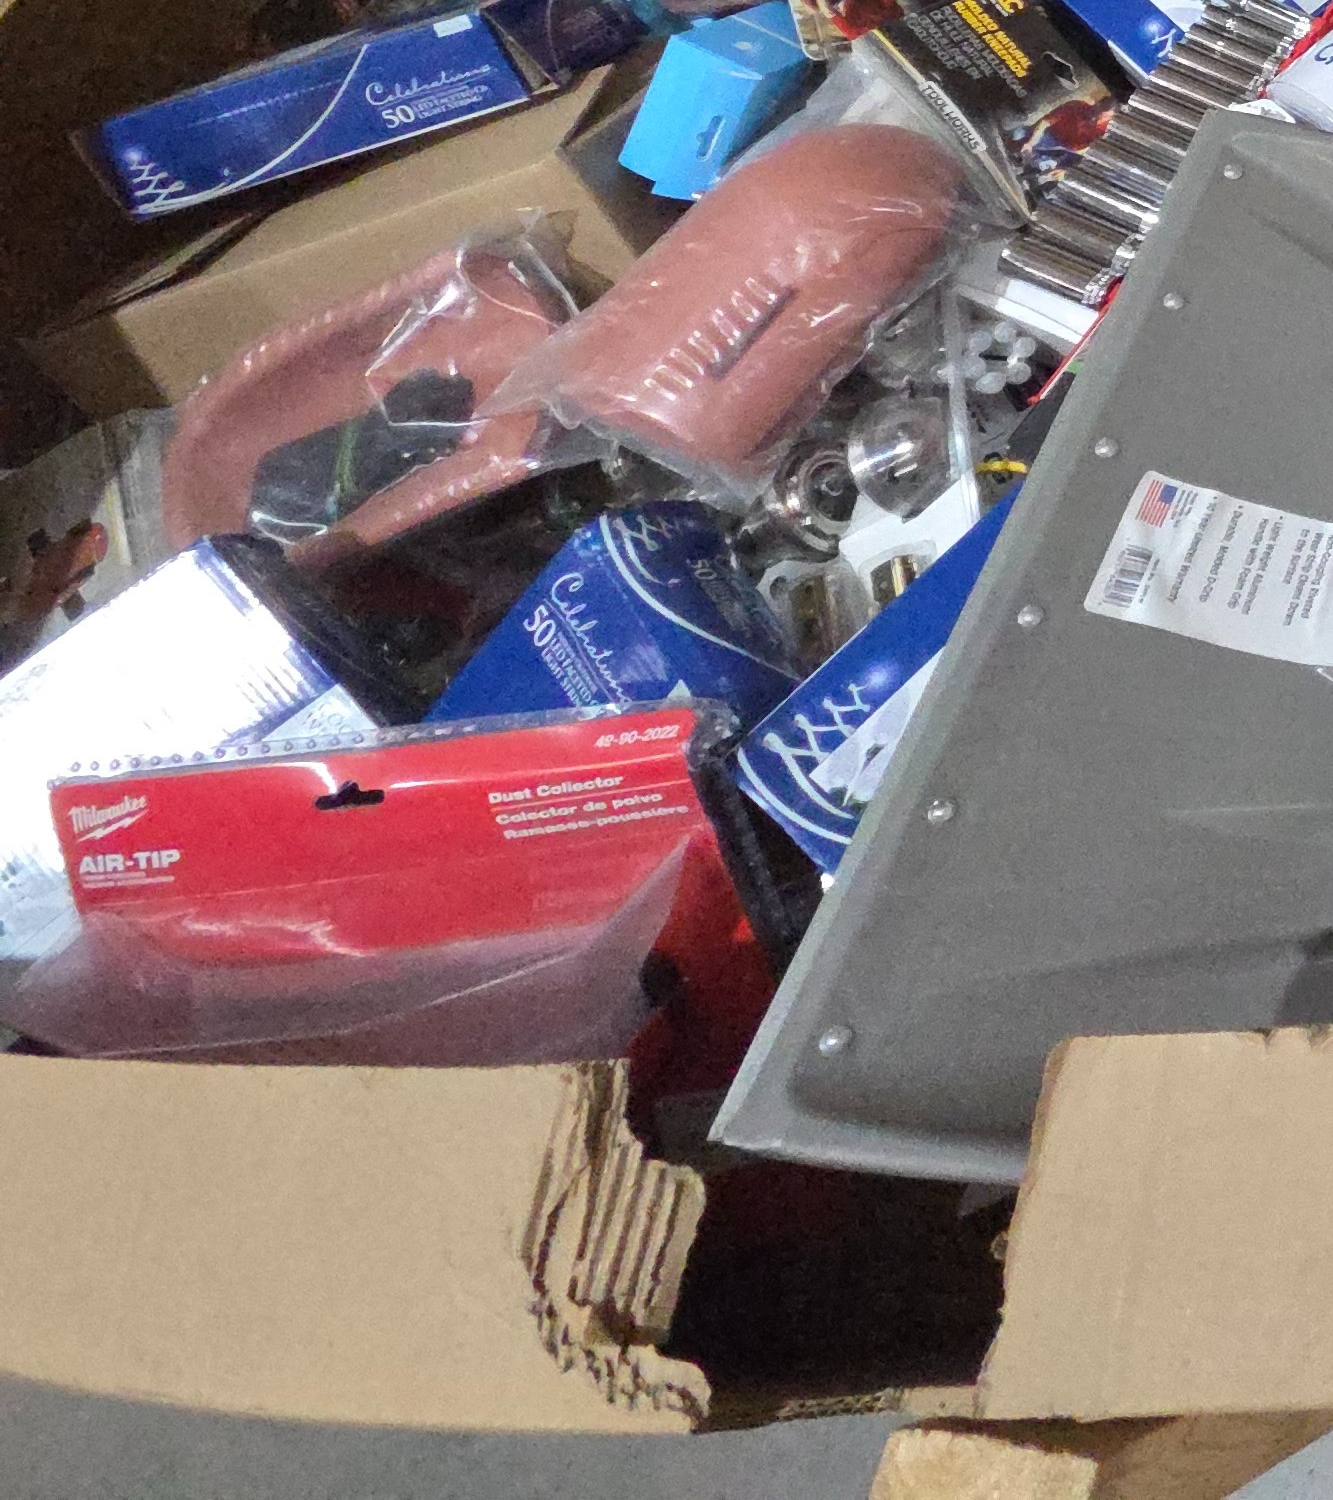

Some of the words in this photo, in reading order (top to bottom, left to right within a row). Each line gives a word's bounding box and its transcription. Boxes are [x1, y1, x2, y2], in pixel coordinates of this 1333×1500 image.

[365, 63, 492, 106] Celebrations
[381, 104, 416, 129] 50
[522, 604, 556, 647] 50
[551, 571, 633, 711] Celebrations
[487, 786, 533, 805] Dust
[534, 775, 624, 798] Collector
[67, 795, 149, 834] Milwaukee
[494, 803, 579, 827] Colector
[584, 799, 609, 815] de
[612, 791, 664, 812] polvo
[77, 848, 181, 876] AIR-TIP
